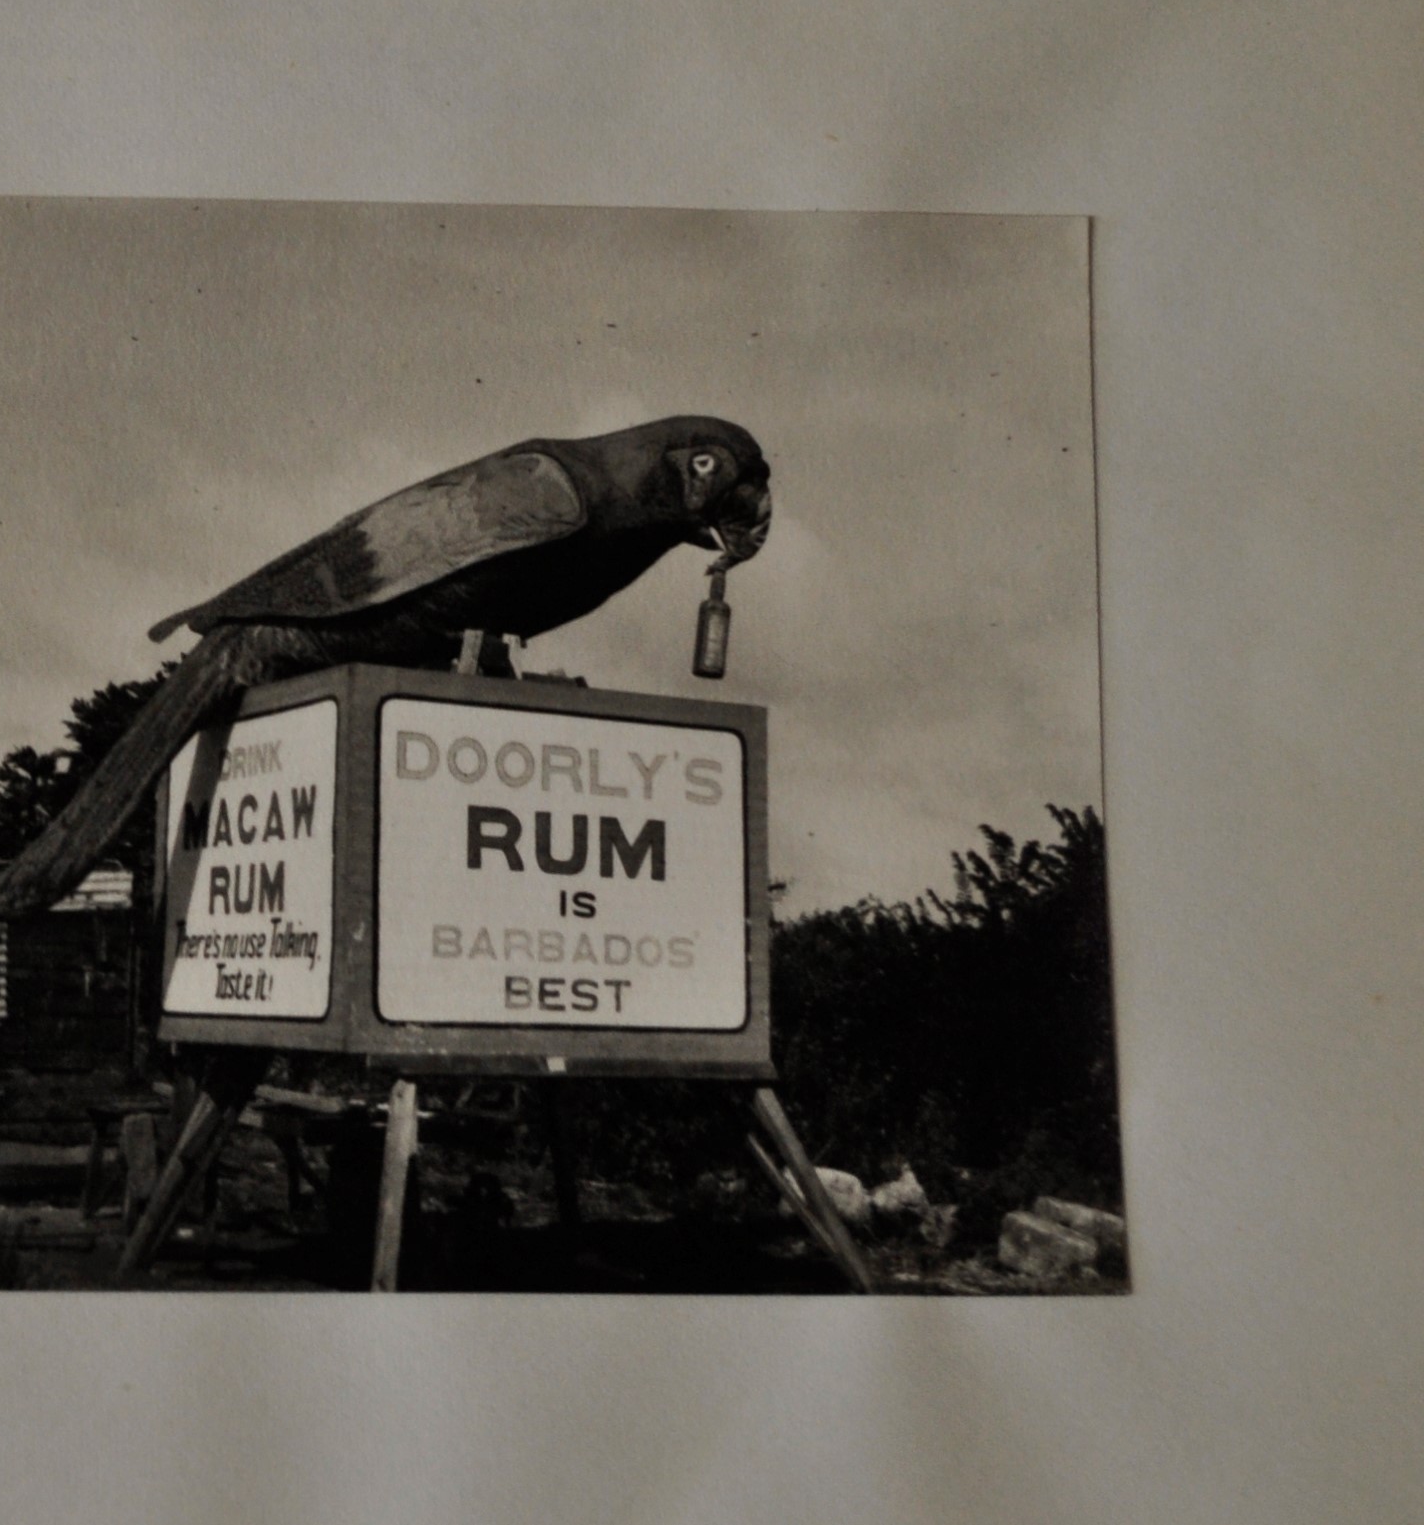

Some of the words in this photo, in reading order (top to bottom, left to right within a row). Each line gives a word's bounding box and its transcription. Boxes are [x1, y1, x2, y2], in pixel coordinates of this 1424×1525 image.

[218, 739, 283, 780] DRINK
[396, 730, 723, 806] DOORLY'S
[183, 784, 316, 851] MACAW
[467, 804, 666, 882] RUM
[208, 861, 285, 915] RUM
[559, 890, 597, 919] IS
[223, 932, 238, 959] no
[240, 932, 266, 959] use
[215, 963, 253, 1002] Taste
[504, 976, 632, 1013] BEST
